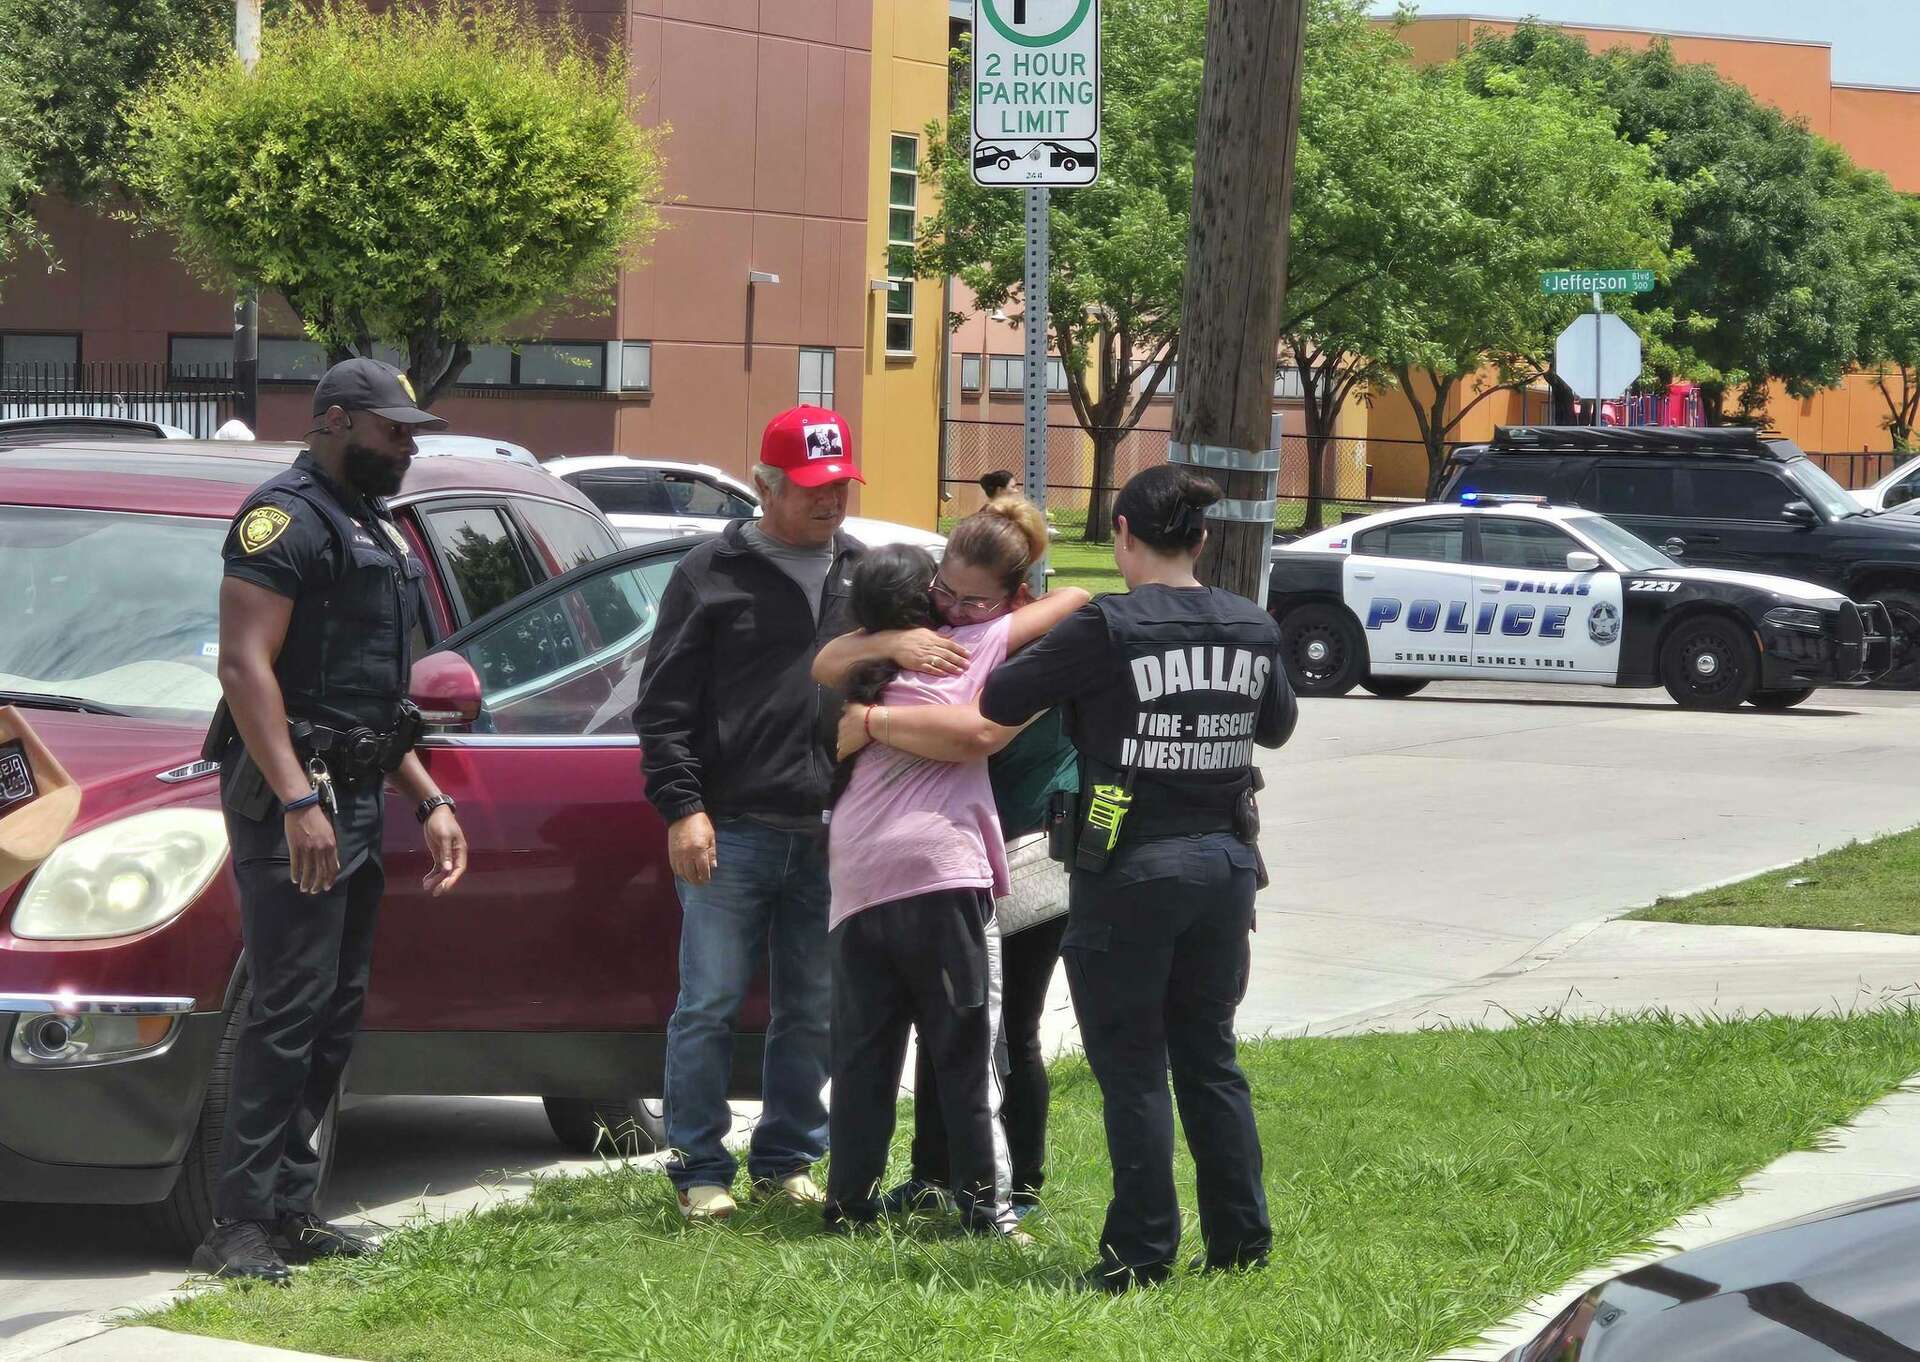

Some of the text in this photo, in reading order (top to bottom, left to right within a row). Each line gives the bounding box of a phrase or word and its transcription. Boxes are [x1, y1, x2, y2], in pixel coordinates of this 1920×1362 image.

[985, 53, 1086, 77] 2 HOUR
[978, 81, 1093, 105] PARKING
[1001, 110, 1070, 133] LIMIT
[1552, 274, 1627, 290] Jefferson
[1631, 271, 1650, 281] Blvd
[250, 509, 287, 526] POLICE
[1503, 580, 1592, 597] DALLAS
[1629, 580, 1682, 593] 2237
[1365, 597, 1571, 638] POLICE
[1394, 652, 1468, 664] SERVING
[1476, 655, 1526, 666] SINCE
[1130, 646, 1271, 703] DALLAS
[1196, 711, 1256, 738] RESCUE
